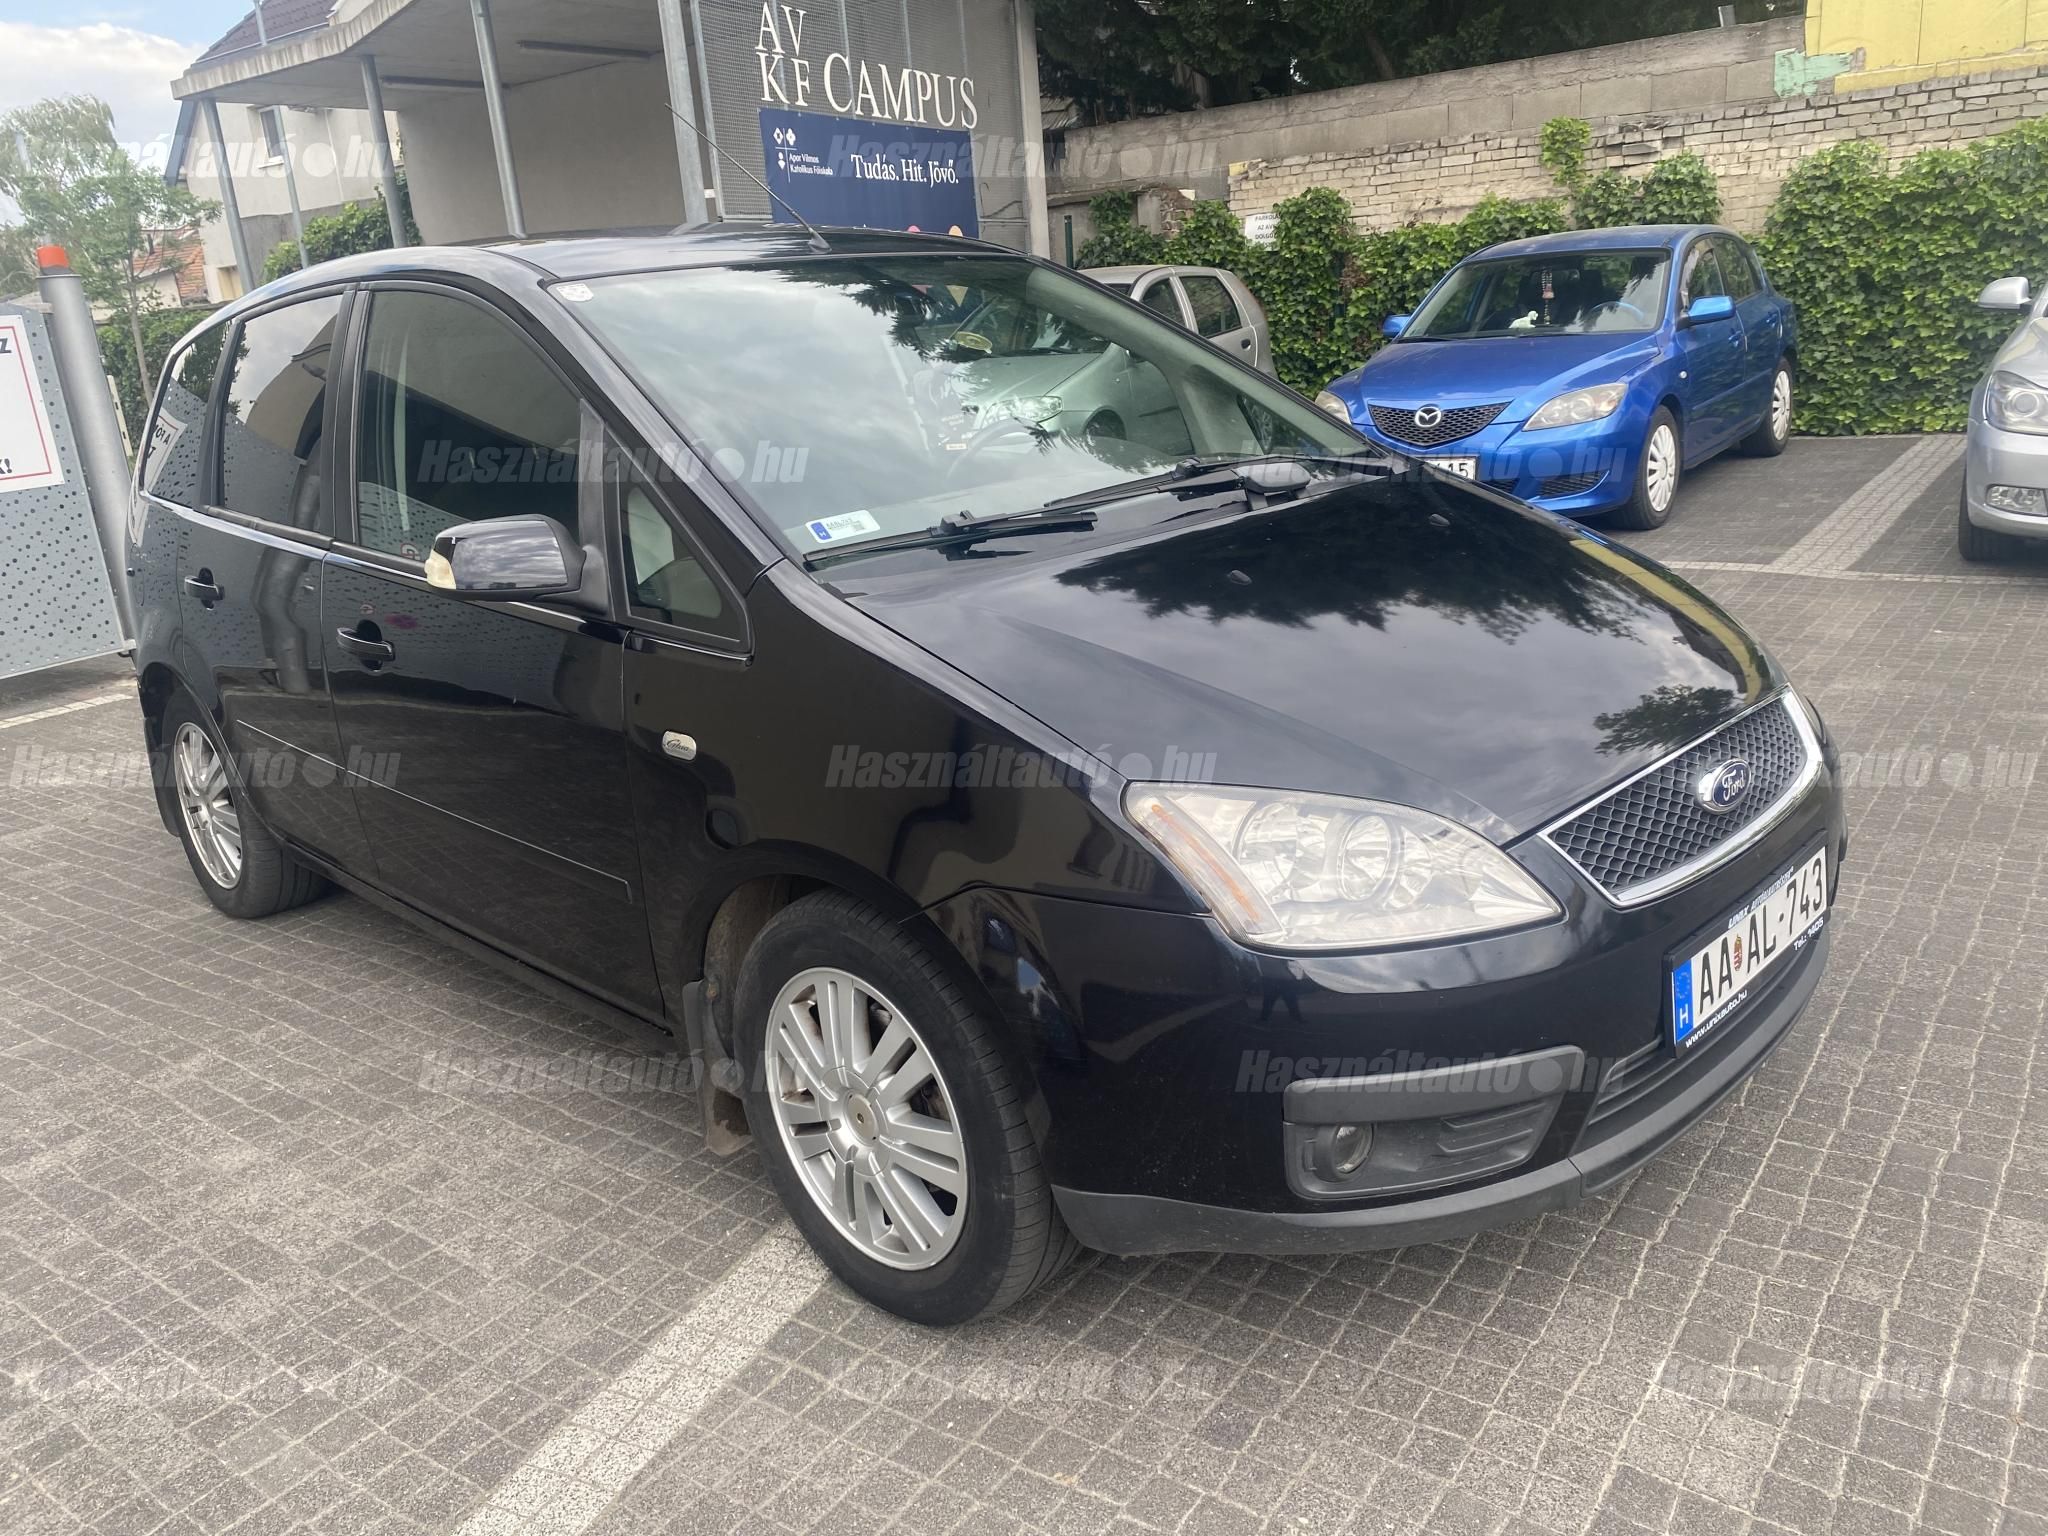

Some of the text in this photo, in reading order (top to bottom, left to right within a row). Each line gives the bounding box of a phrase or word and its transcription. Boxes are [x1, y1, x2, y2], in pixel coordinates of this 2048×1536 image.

[755, 2, 807, 56] AV
[755, 52, 978, 129] KF CAMPUS
[851, 154, 959, 188] Tudás. Hit. Jövő.
[1722, 769, 1745, 801] Ford
[1679, 1003, 1689, 1028] H
